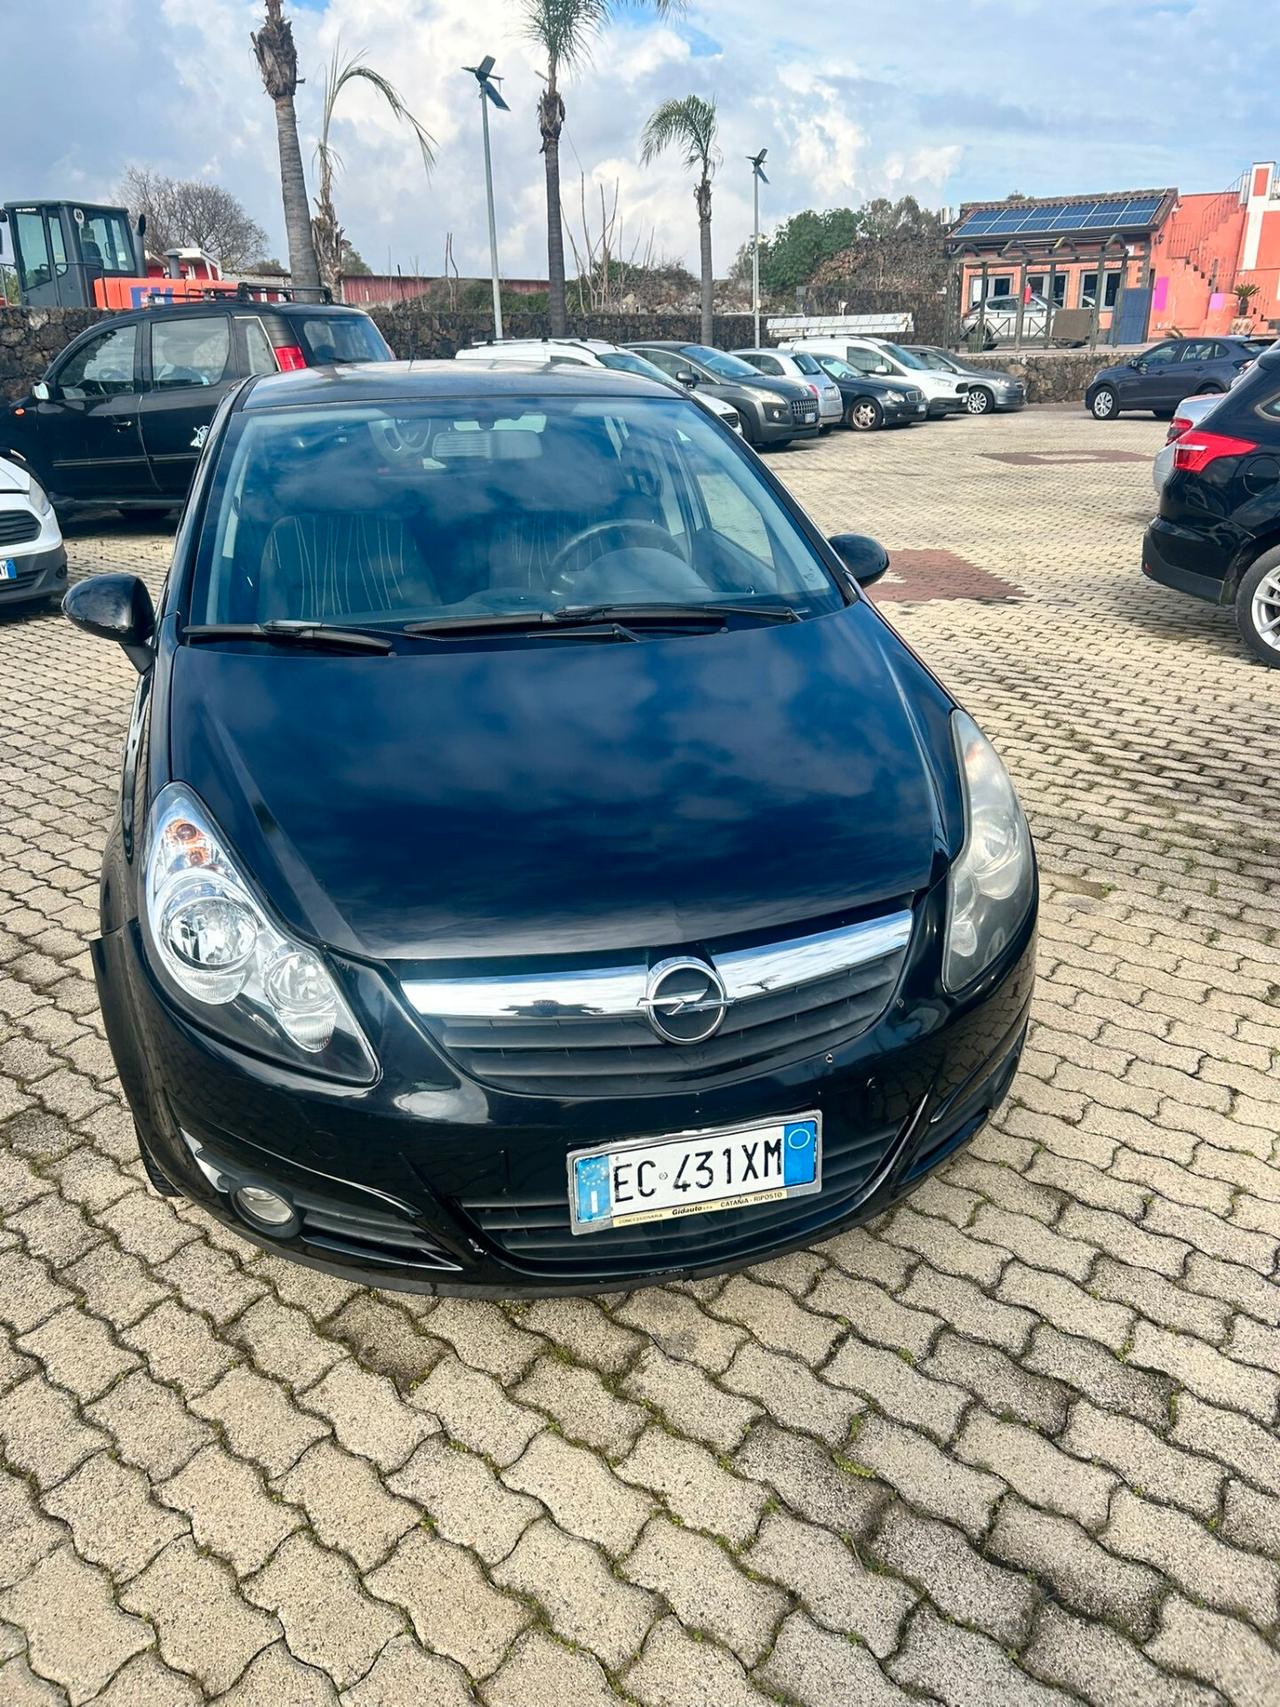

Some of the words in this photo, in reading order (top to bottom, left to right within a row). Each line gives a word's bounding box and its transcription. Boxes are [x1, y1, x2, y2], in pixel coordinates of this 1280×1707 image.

[614, 1160, 657, 1203] EC
[673, 1138, 782, 1192] 431XM
[720, 1197, 749, 1208] CATANIA
[753, 1192, 783, 1202] RIPOSTO
[672, 1205, 702, 1216] Gidauto
